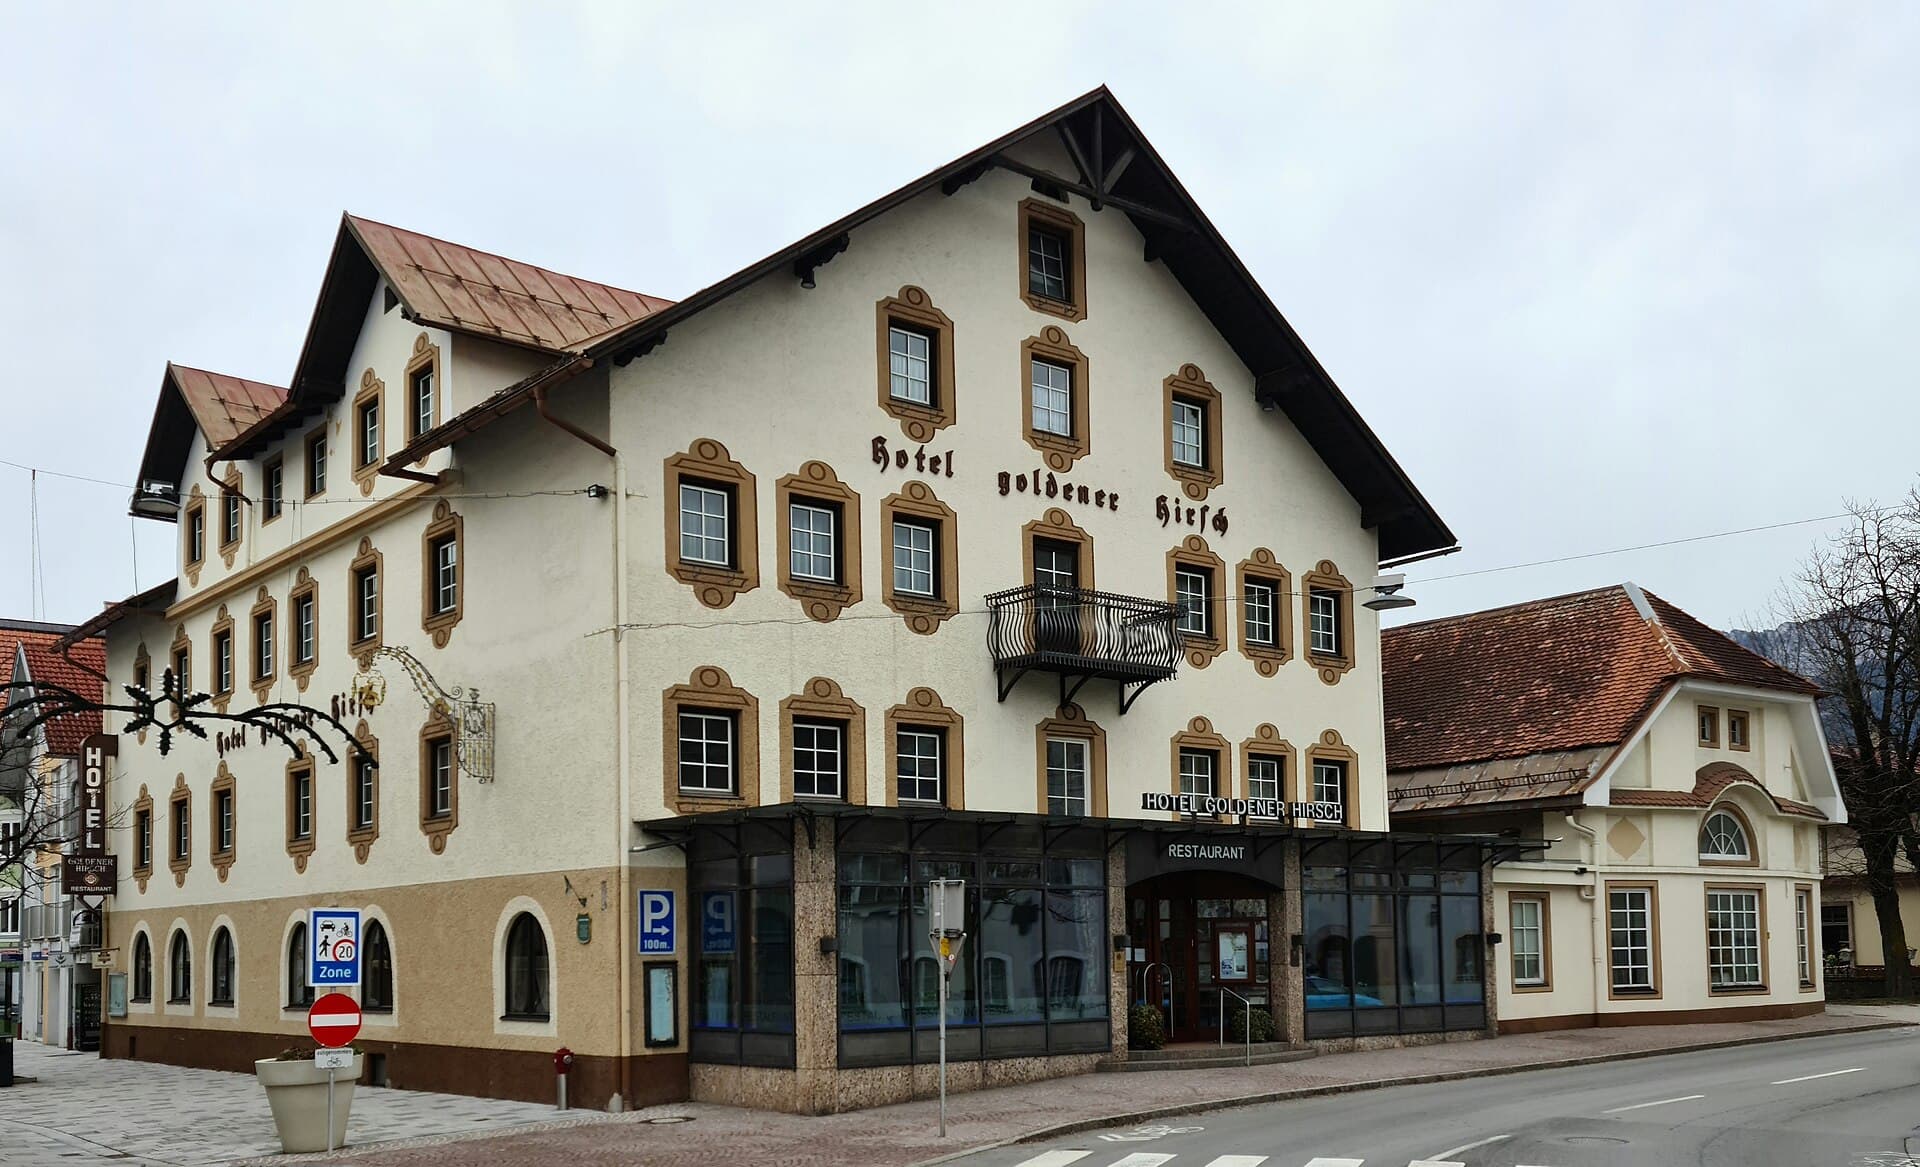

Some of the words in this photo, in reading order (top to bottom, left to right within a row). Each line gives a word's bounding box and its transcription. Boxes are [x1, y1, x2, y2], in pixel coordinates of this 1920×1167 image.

[871, 435, 955, 478] Hotel
[998, 468, 1120, 512] goldener
[1156, 494, 1229, 537] Hirsch
[216, 724, 246, 759] Hotel
[86, 747, 101, 849] HOTEL
[1144, 793, 1198, 812] HOTEL
[1205, 797, 1285, 816] GOLDENER
[1293, 802, 1343, 819] HIRSCH
[1168, 843, 1245, 860] RESTAURANT
[643, 894, 670, 933] P
[338, 945, 353, 959] 20
[319, 966, 351, 978] Zone
